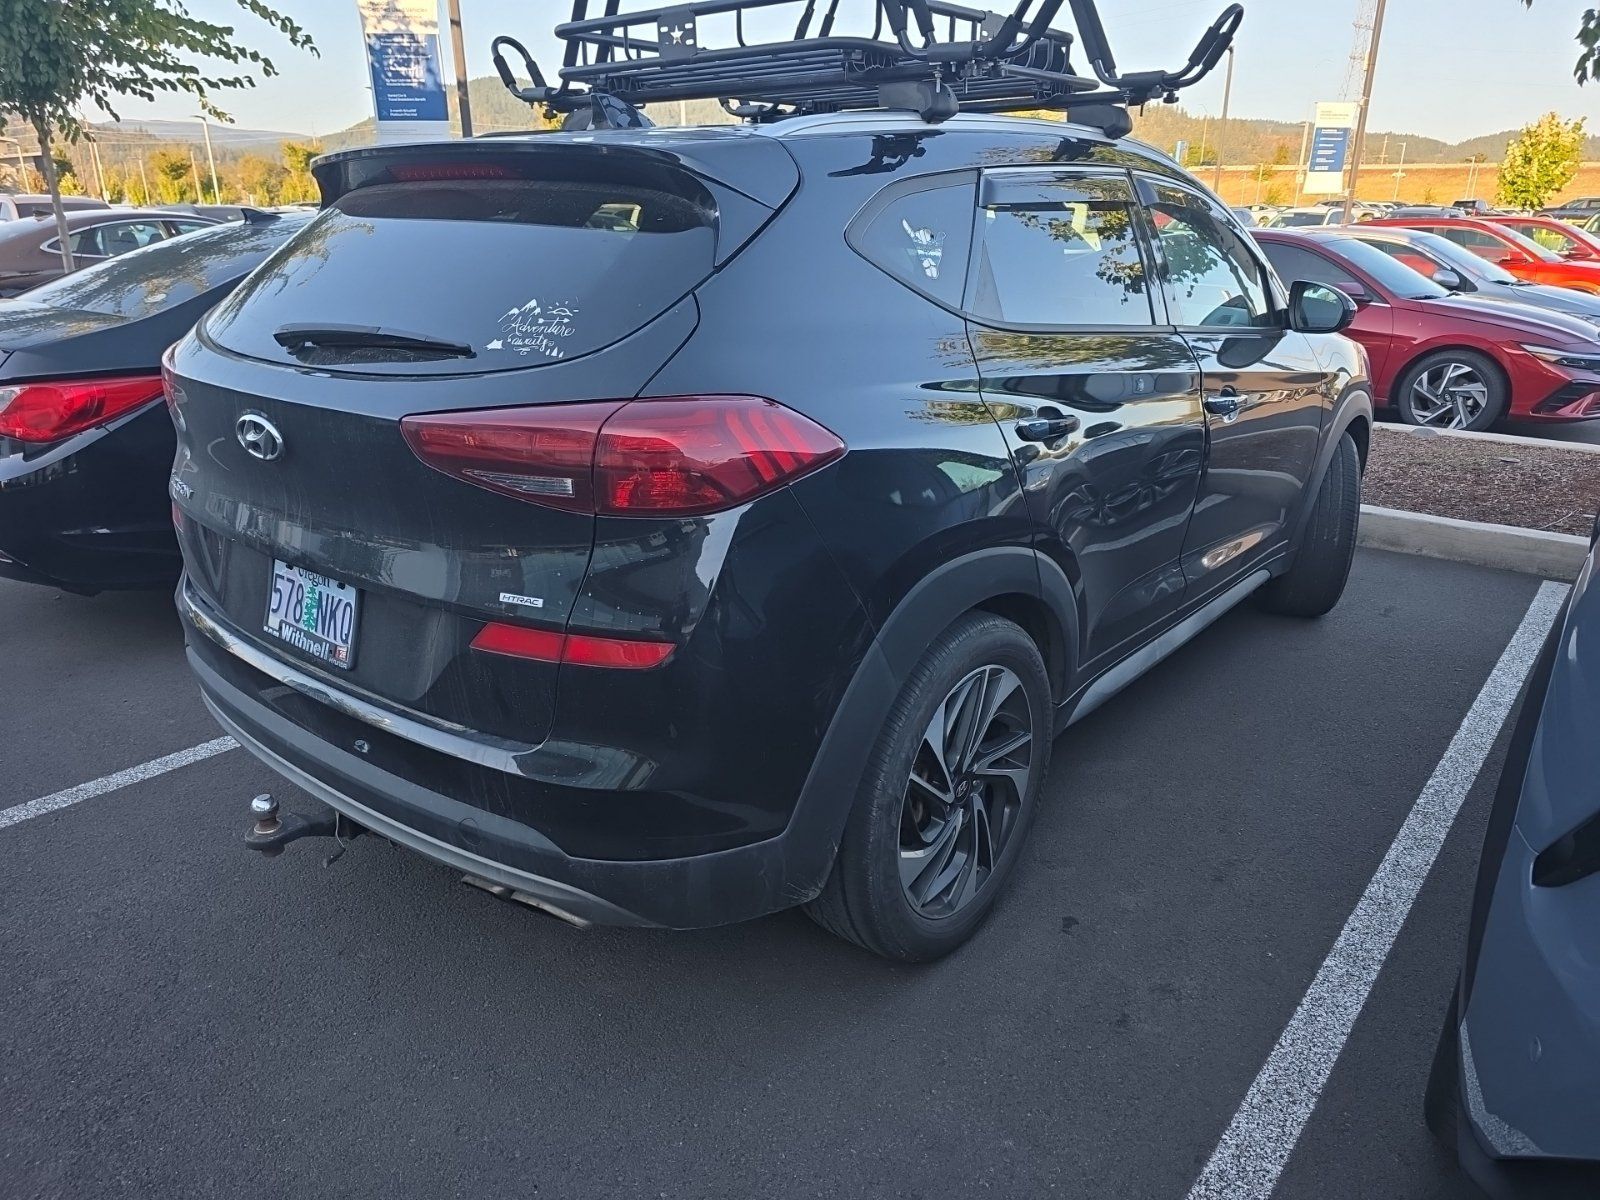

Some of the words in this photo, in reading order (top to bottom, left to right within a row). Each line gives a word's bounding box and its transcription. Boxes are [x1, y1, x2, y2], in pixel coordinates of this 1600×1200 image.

[502, 316, 576, 337] Adventure
[507, 333, 555, 352] awaits
[271, 573, 304, 623] 578
[502, 594, 540, 606] HTRAC
[281, 622, 330, 660] Withnell
